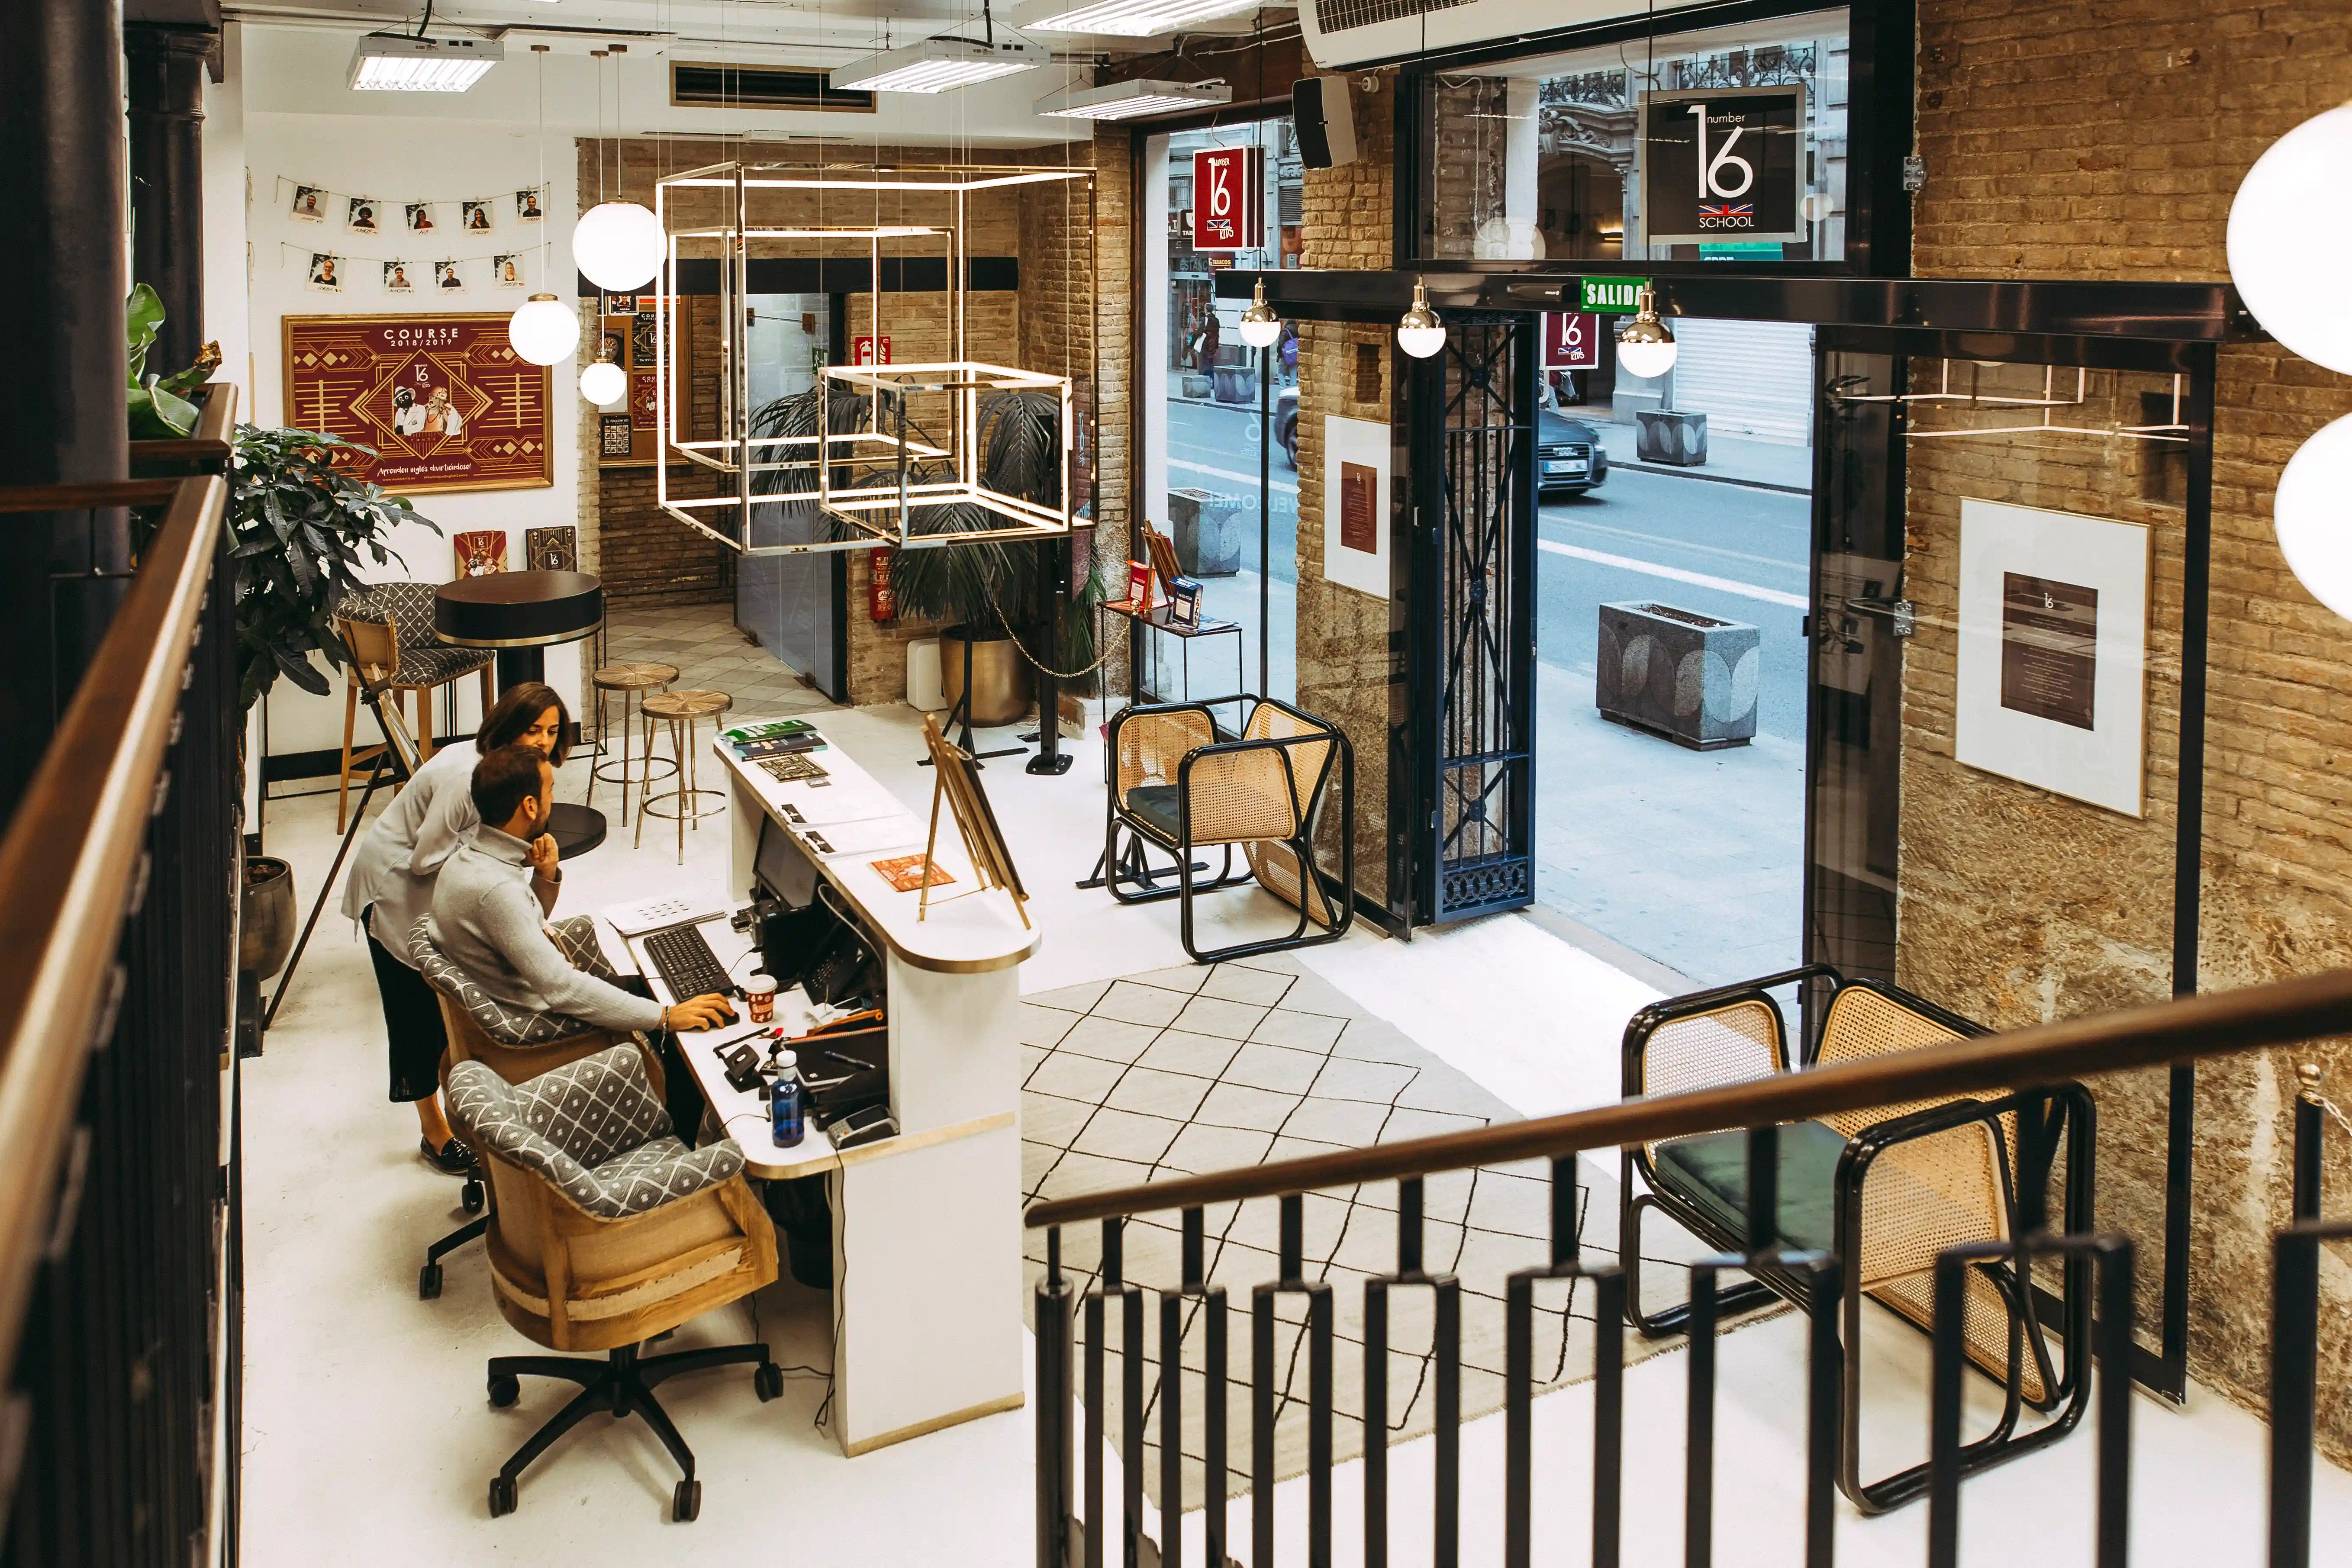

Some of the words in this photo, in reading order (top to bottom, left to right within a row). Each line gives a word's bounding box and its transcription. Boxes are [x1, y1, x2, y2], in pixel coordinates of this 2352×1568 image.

[1707, 112, 1746, 123] number
[1687, 104, 1753, 198] 16
[1208, 157, 1230, 216] 16
[1699, 216, 1754, 228] SCHOOL
[1220, 227, 1234, 240] KIDS
[384, 328, 458, 340] COURSE
[1562, 312, 1582, 346] 16
[1571, 352, 1585, 361] KIDS
[414, 364, 428, 381] 16
[550, 553, 558, 565] 16
[2044, 592, 2053, 609] 16
